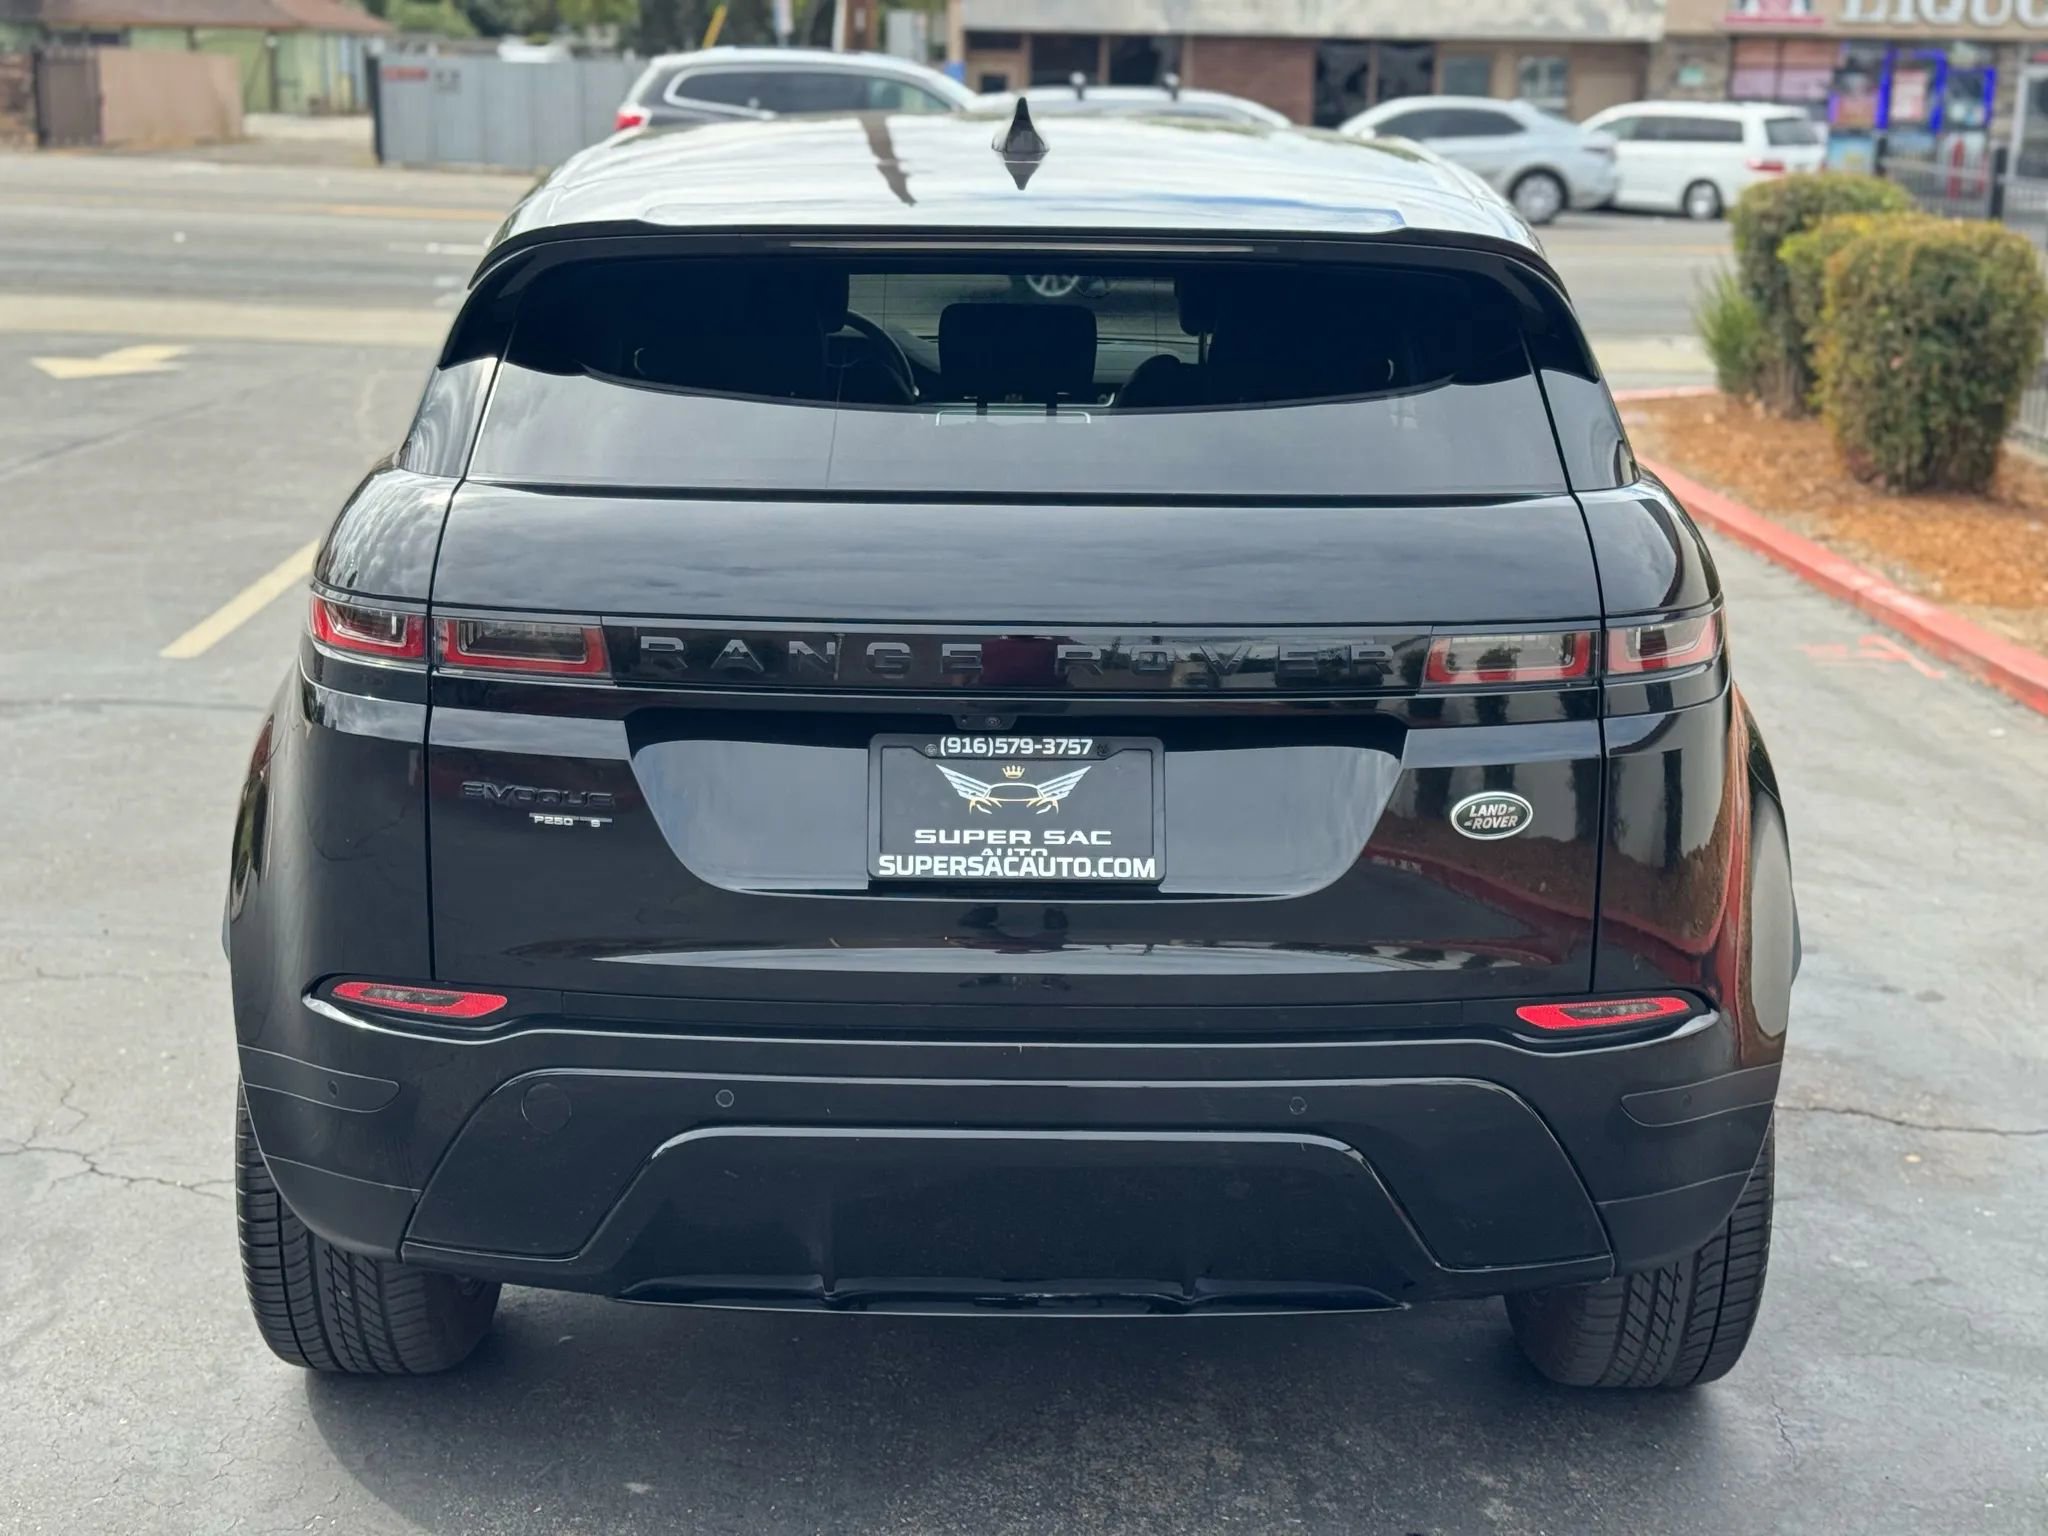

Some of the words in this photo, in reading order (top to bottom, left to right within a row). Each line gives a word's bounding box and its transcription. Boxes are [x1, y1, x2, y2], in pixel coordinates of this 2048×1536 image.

[640, 635, 984, 679] RANGE
[1056, 643, 1396, 678] ROVER
[940, 736, 1093, 757] (916)579-3757
[461, 781, 615, 808] EVOQUE
[1469, 804, 1507, 817] LAND
[533, 815, 574, 826] P250
[1472, 815, 1518, 829] ROVER
[914, 829, 1031, 845] SUPER
[1043, 830, 1112, 845] SAC
[878, 855, 1156, 878] SUPERSACAUTO.COM
